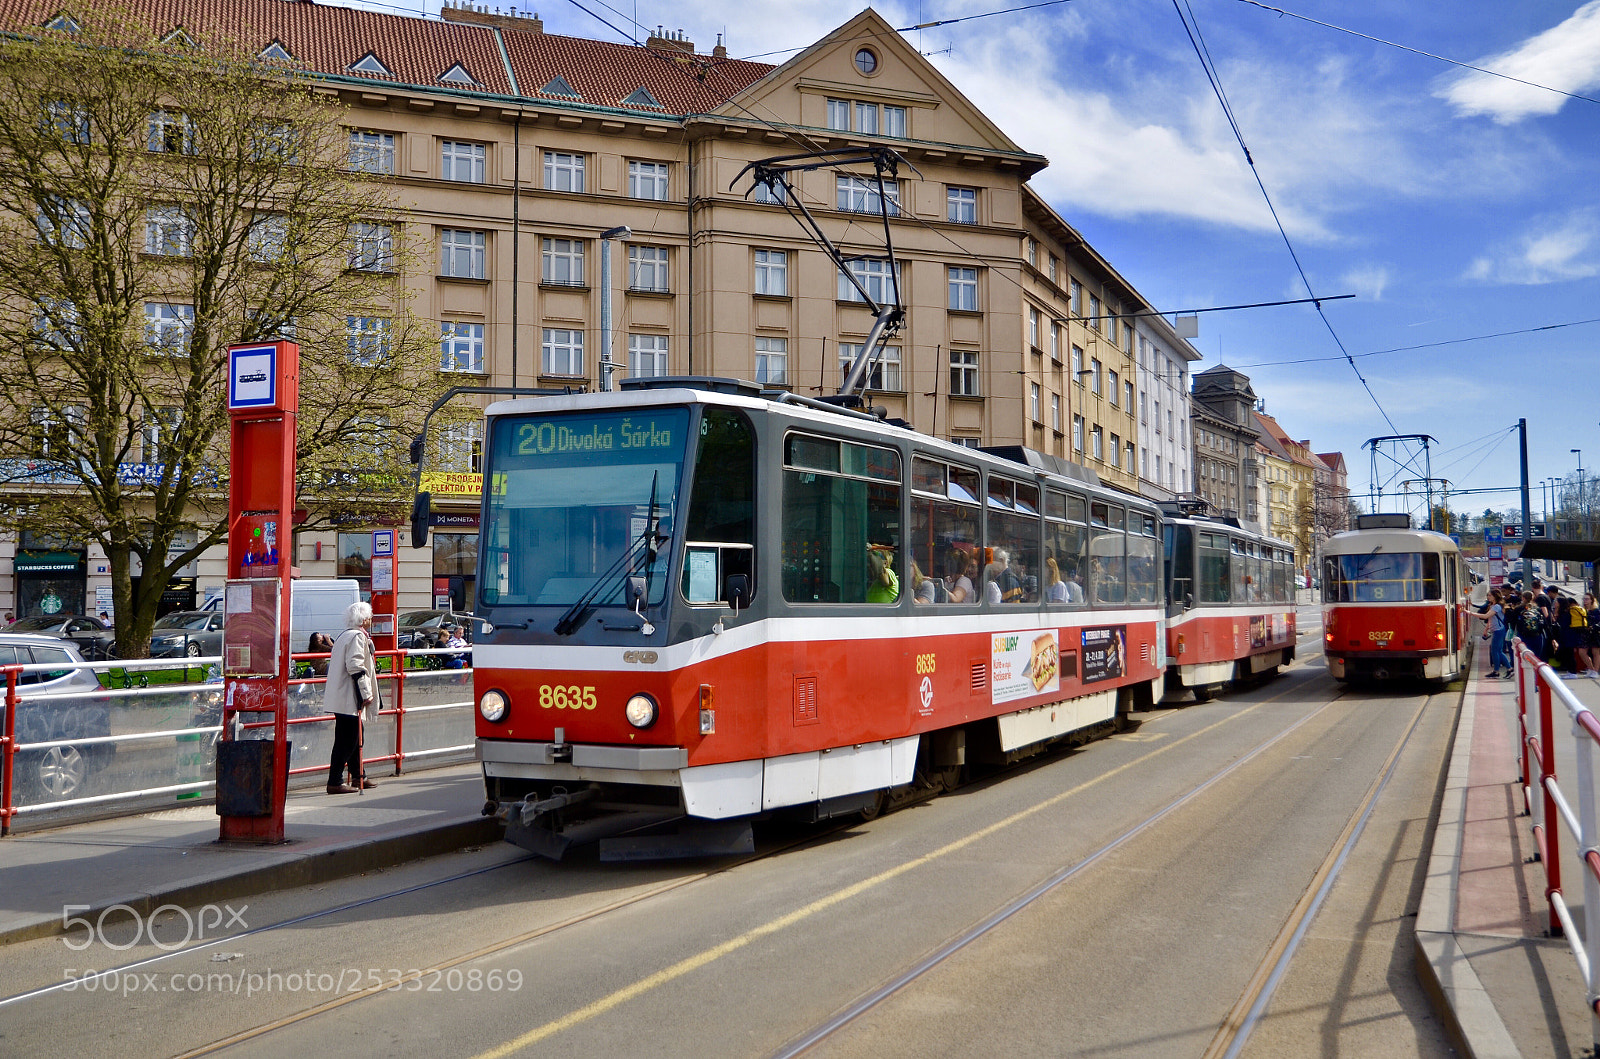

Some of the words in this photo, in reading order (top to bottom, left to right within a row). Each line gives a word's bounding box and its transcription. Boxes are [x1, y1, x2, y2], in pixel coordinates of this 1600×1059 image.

[519, 423, 555, 454] 20
[558, 425, 613, 450] Divoká
[621, 418, 670, 448] Šárka
[1374, 587, 1384, 599] 8
[993, 636, 1019, 653] SUBWAY
[1368, 631, 1394, 641] 8327
[916, 653, 936, 674] 8635
[539, 684, 598, 710] 8635
